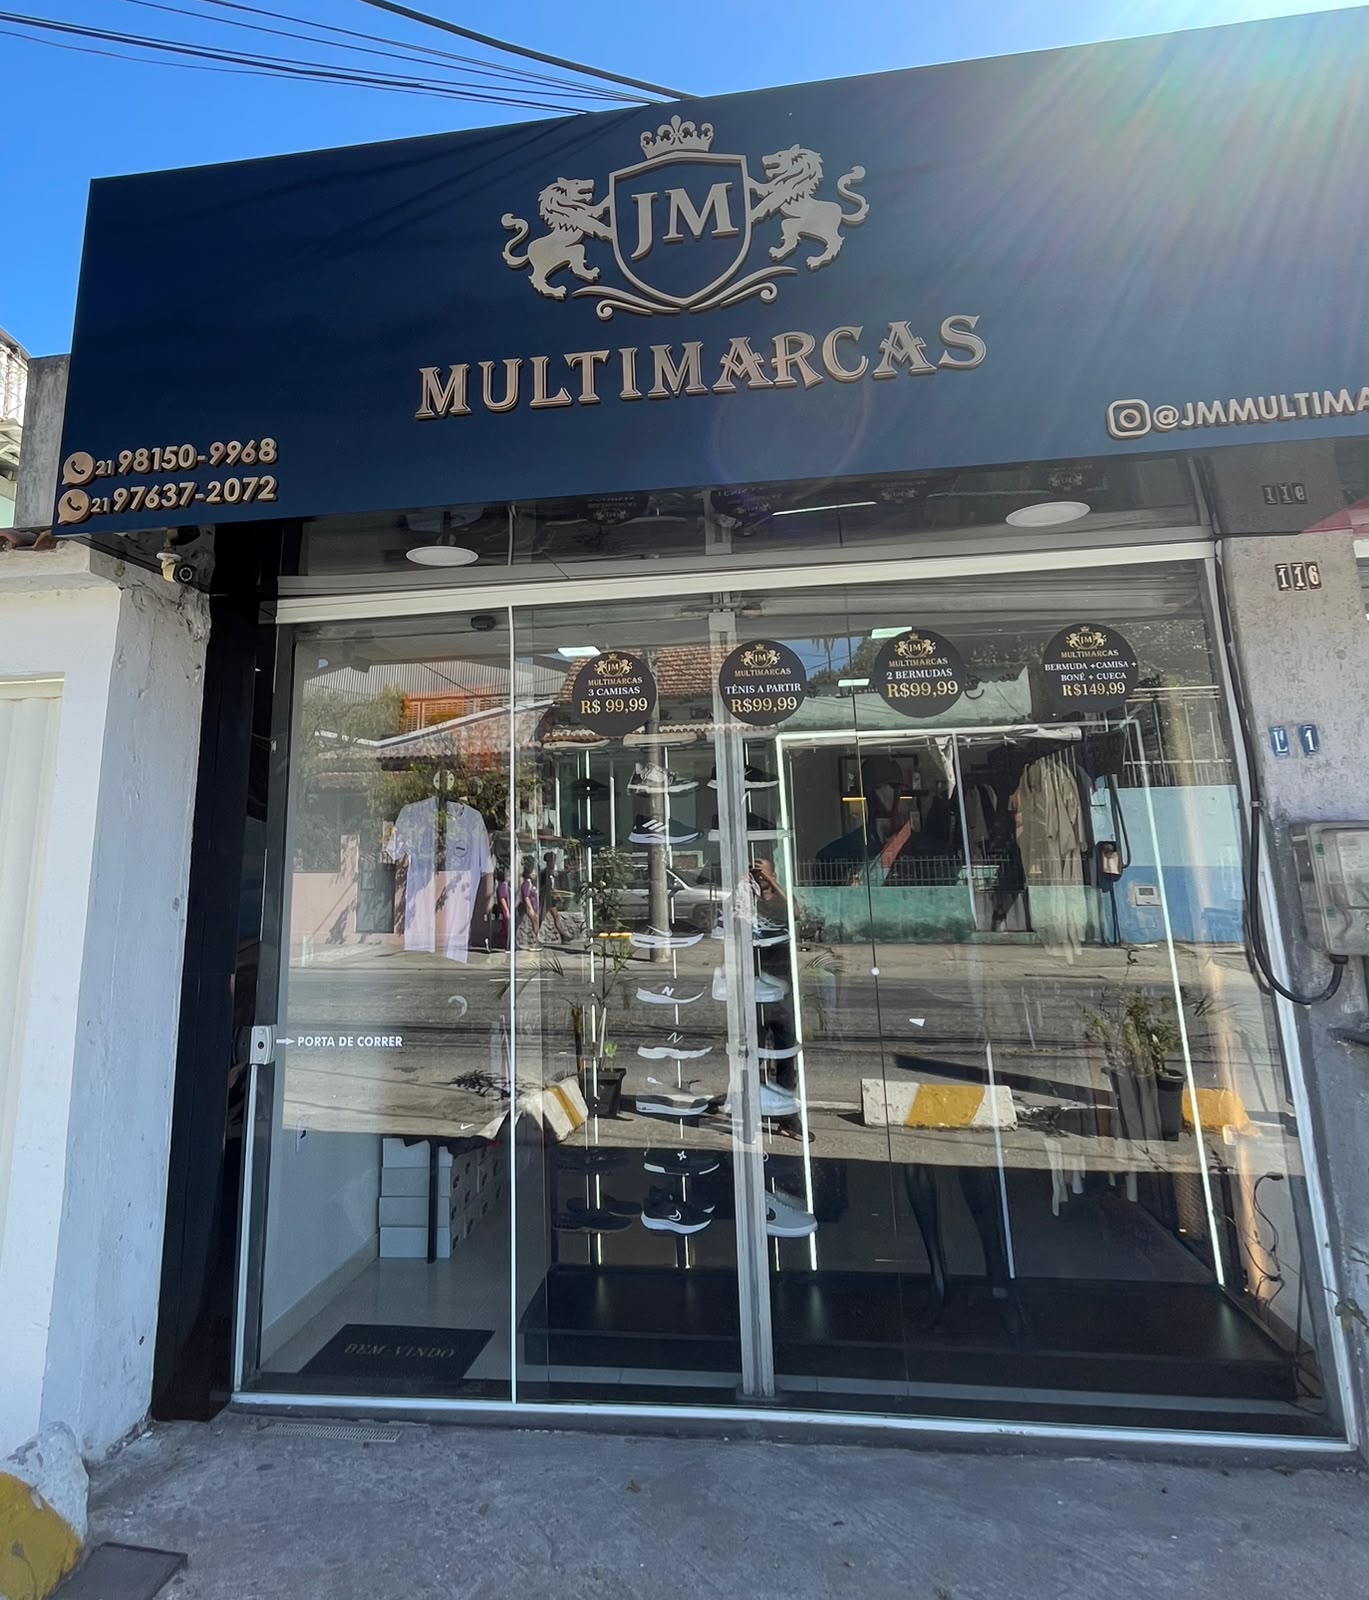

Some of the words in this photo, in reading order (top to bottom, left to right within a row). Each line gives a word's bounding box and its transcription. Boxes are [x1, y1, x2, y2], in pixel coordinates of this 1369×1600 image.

[631, 182, 739, 260] JM
[414, 314, 987, 420] MULTIMARCAS
[94, 459, 114, 476] 21
[118, 437, 278, 475] 98150-9968
[90, 497, 111, 514] 21
[113, 475, 278, 513] 97637-2072
[1276, 563, 1321, 590] 116
[1061, 649, 1119, 659] MULTIMARCAS
[888, 657, 949, 668] MULTIMARCAS
[1044, 662, 1089, 672] BERMUDA
[734, 667, 792, 677] MULTIMARCAS
[887, 672, 893, 680] 2
[895, 668, 953, 679] BERMUDAS
[1061, 671, 1086, 682] BONÉ
[1097, 672, 1127, 681] CUECA
[588, 676, 643, 686] MULTIMARCAS
[588, 688, 595, 696] 3
[597, 686, 641, 695] CAMISAS
[725, 684, 755, 694] TÊNIS
[757, 684, 764, 693] A
[766, 682, 802, 692] PARTIR
[887, 680, 959, 699] R$99,99
[1062, 682, 1126, 697] R$149,99
[581, 700, 601, 715] R$
[605, 697, 648, 713] 99,99
[731, 697, 798, 713] R$99,99
[297, 1036, 336, 1047] PORTA
[338, 1036, 354, 1047] DE
[357, 1036, 403, 1047] CORRER
